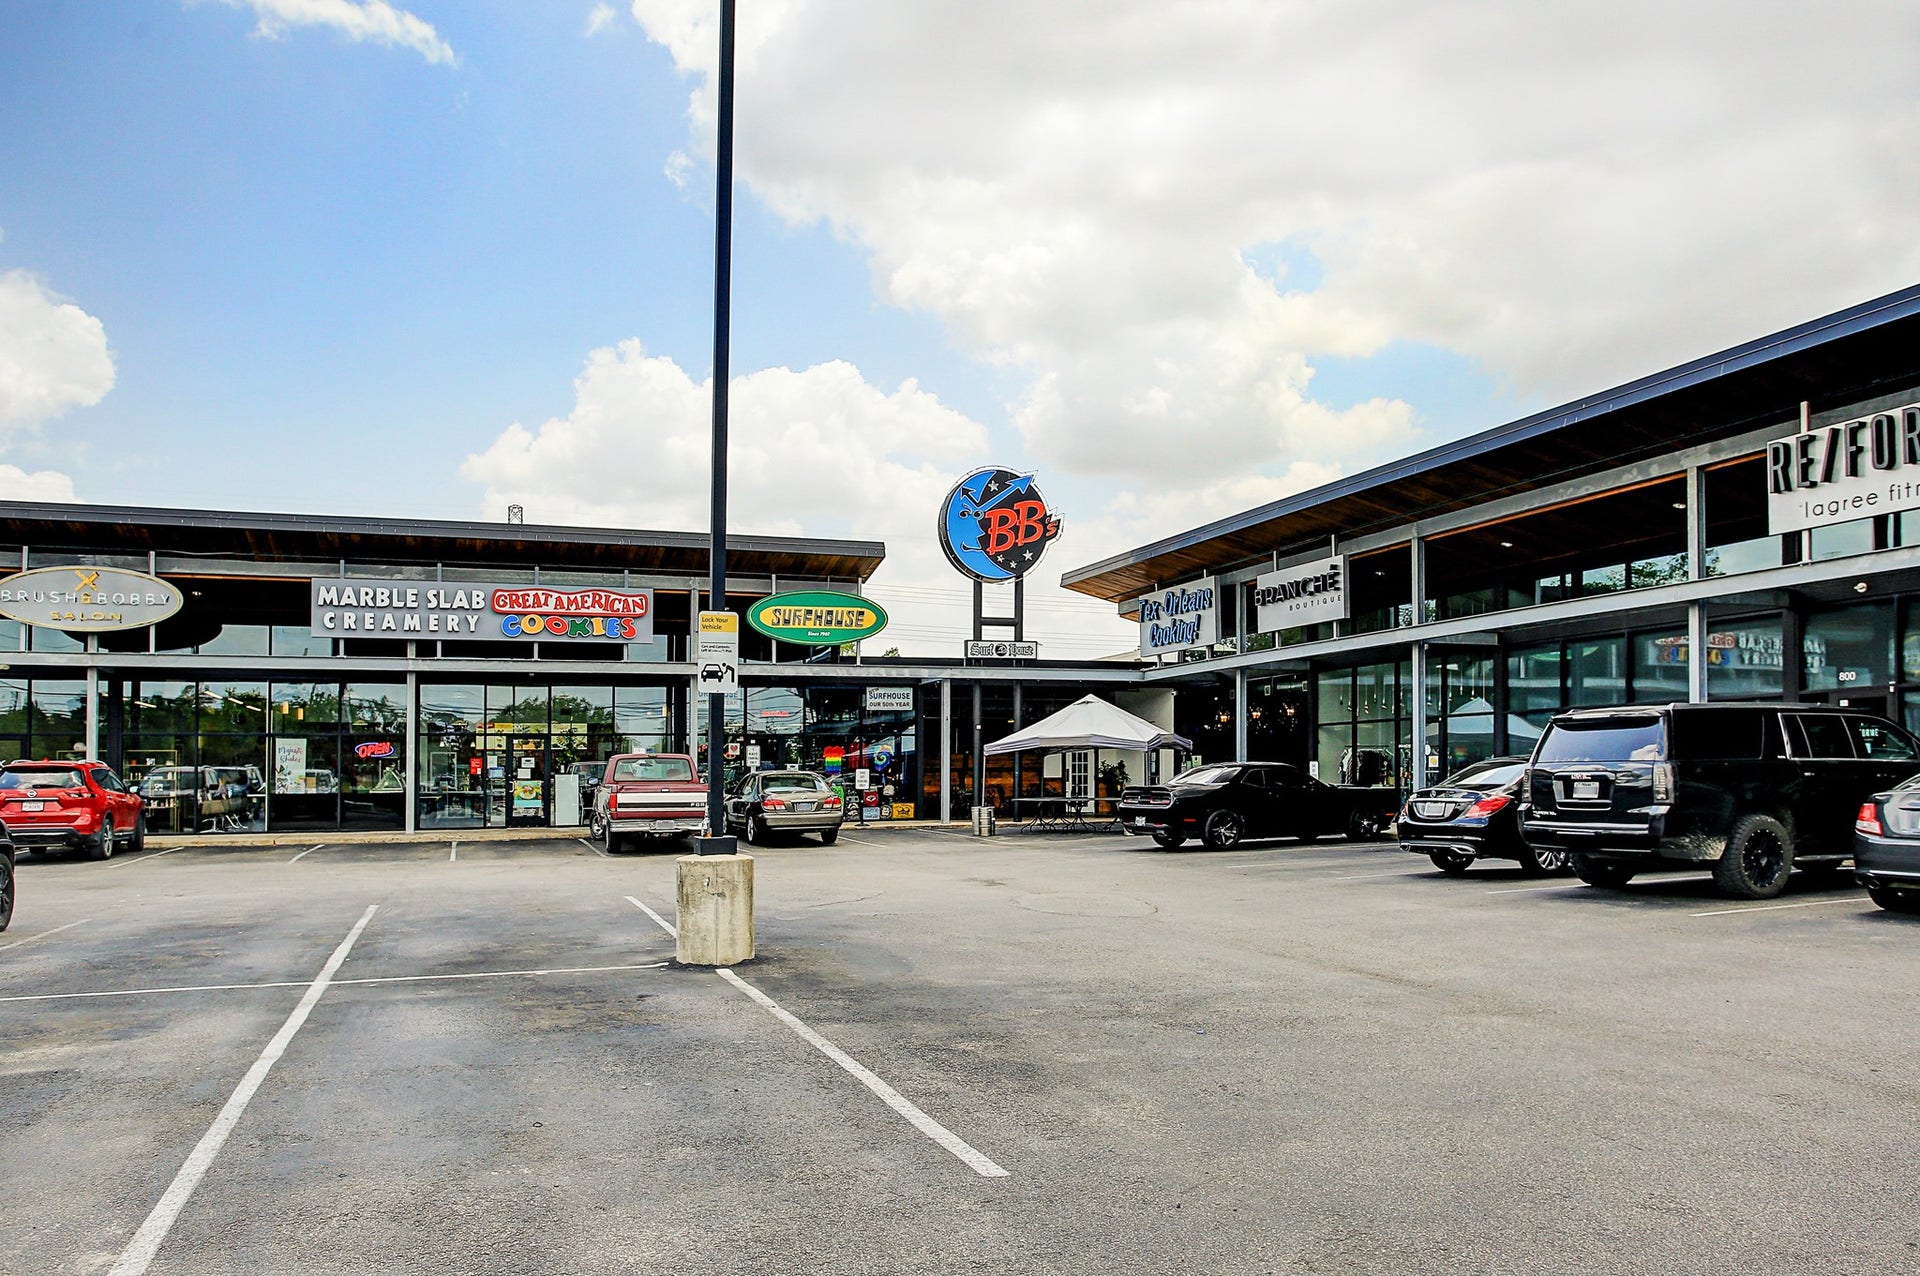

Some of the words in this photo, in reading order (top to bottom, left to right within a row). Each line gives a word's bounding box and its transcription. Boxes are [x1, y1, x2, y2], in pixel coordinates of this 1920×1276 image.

[1805, 492, 1878, 518] lagree
[984, 500, 1059, 555] BB's
[317, 586, 418, 609] MARBLE
[426, 588, 486, 610] SLAB
[495, 592, 552, 610] GREAT
[553, 591, 645, 614] AMERICAN
[1289, 595, 1342, 612] BOUTIQUE
[50, 611, 122, 623] SALON
[323, 612, 480, 633] CREAMERY
[501, 614, 638, 639] COOKIES
[771, 608, 865, 628] SURFHOUSE
[1149, 614, 1201, 648] Cooking!
[970, 642, 994, 656] Surf
[1009, 643, 1034, 657] House
[1839, 671, 1856, 681] 800
[869, 692, 911, 700] SURFHOUSE
[359, 742, 391, 759] OPEN
